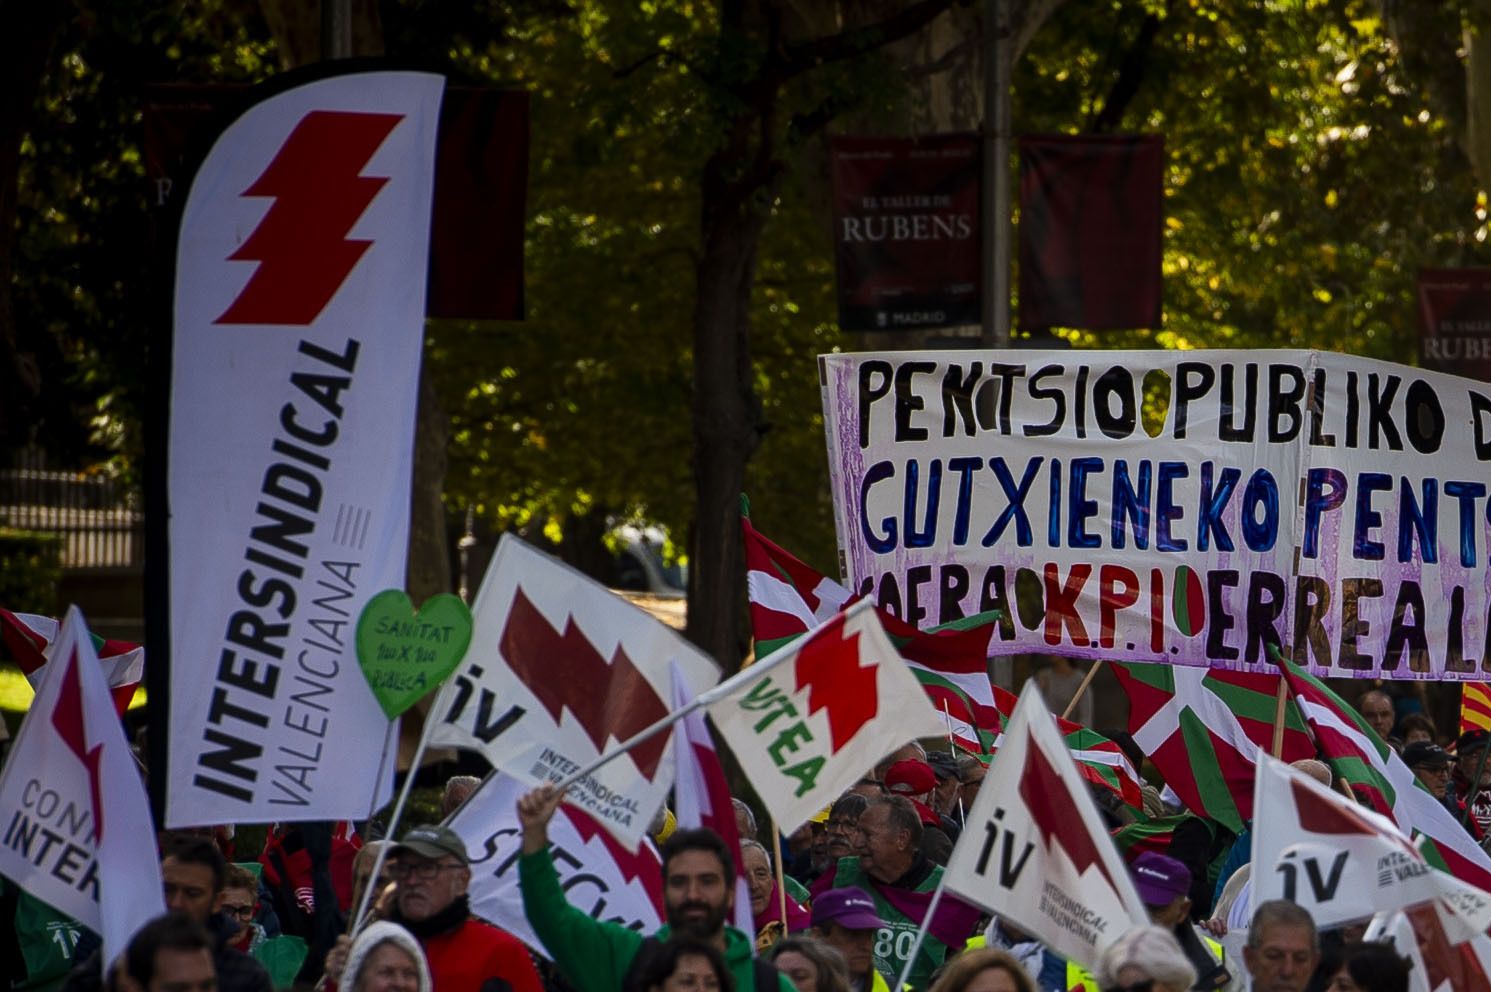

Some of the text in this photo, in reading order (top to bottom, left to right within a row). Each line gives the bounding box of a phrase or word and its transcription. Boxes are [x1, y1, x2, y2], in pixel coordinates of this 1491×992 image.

[841, 214, 972, 242] RUBENS
[859, 361, 1137, 449] PENTSIO
[1173, 362, 1446, 455] PUBLIKO
[860, 456, 1280, 553] GUTXIENEKO
[194, 337, 361, 805] INTERSINDICAL
[268, 559, 362, 808] VALENCIANA
